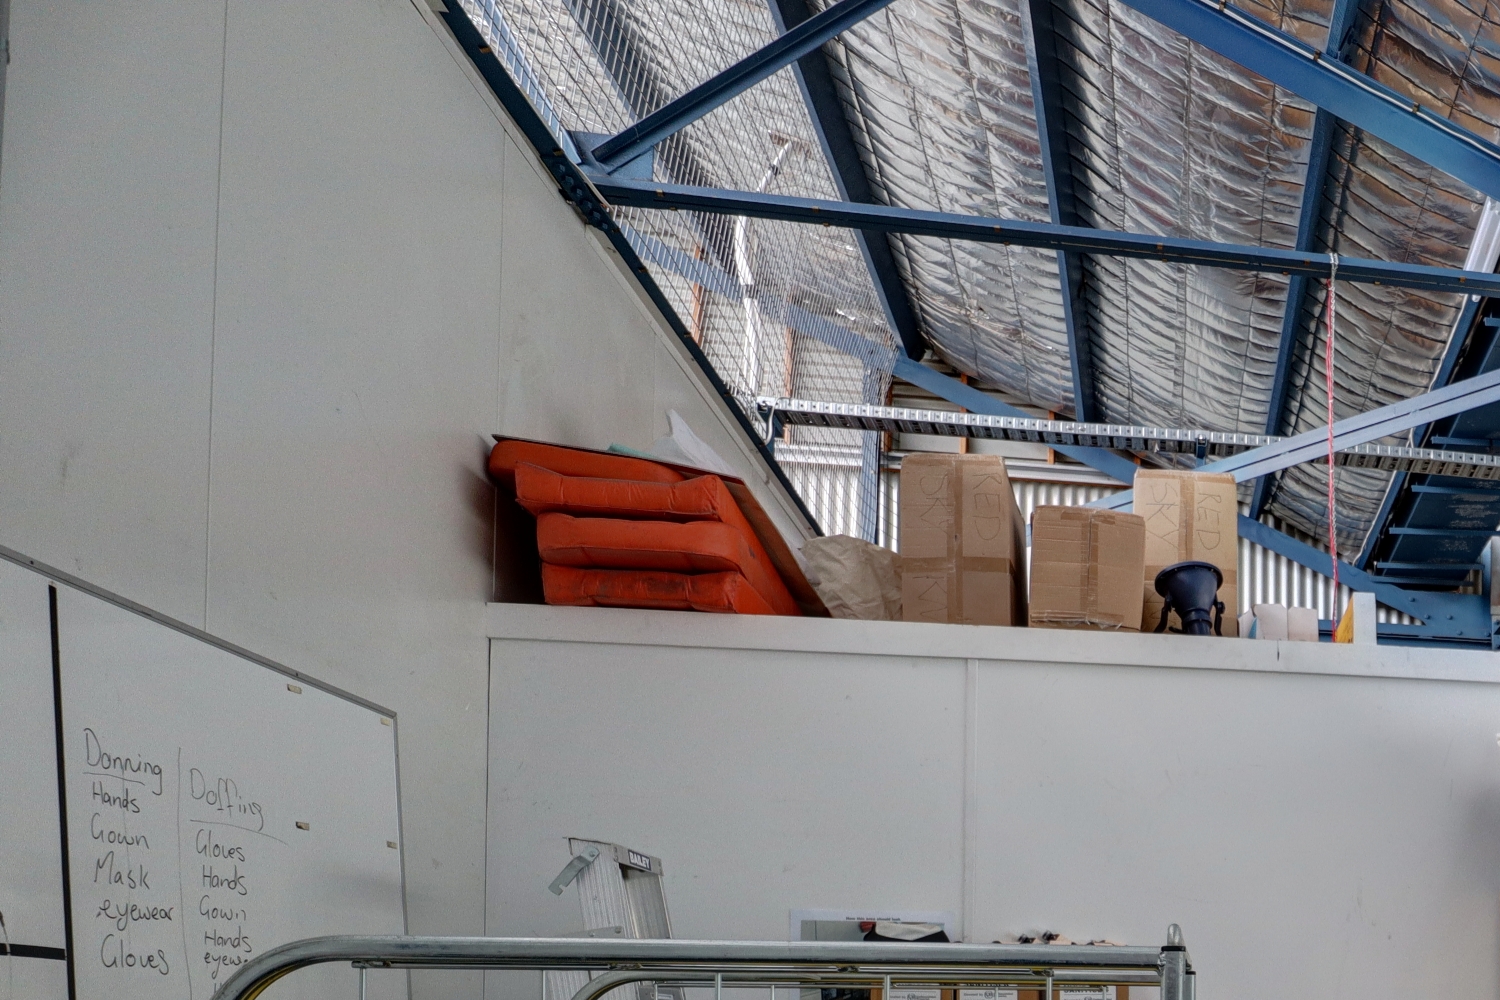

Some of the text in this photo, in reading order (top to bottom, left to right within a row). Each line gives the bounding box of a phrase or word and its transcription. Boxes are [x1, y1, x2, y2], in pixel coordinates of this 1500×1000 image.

[973, 472, 1003, 541] RED
[1146, 482, 1180, 550] SKY
[1196, 492, 1222, 551] RED
[83, 727, 163, 796] Donning
[93, 780, 140, 813] Hands
[190, 767, 264, 832] Doffing
[91, 812, 150, 850] Gown
[196, 828, 246, 862] Gloves
[94, 850, 150, 889] Mask
[202, 863, 247, 895] Hands
[629, 851, 650, 869] BAILEY
[96, 899, 175, 931] eyewear
[199, 894, 246, 922] Gown
[101, 933, 169, 976] Gloves
[204, 925, 252, 952] Hands
